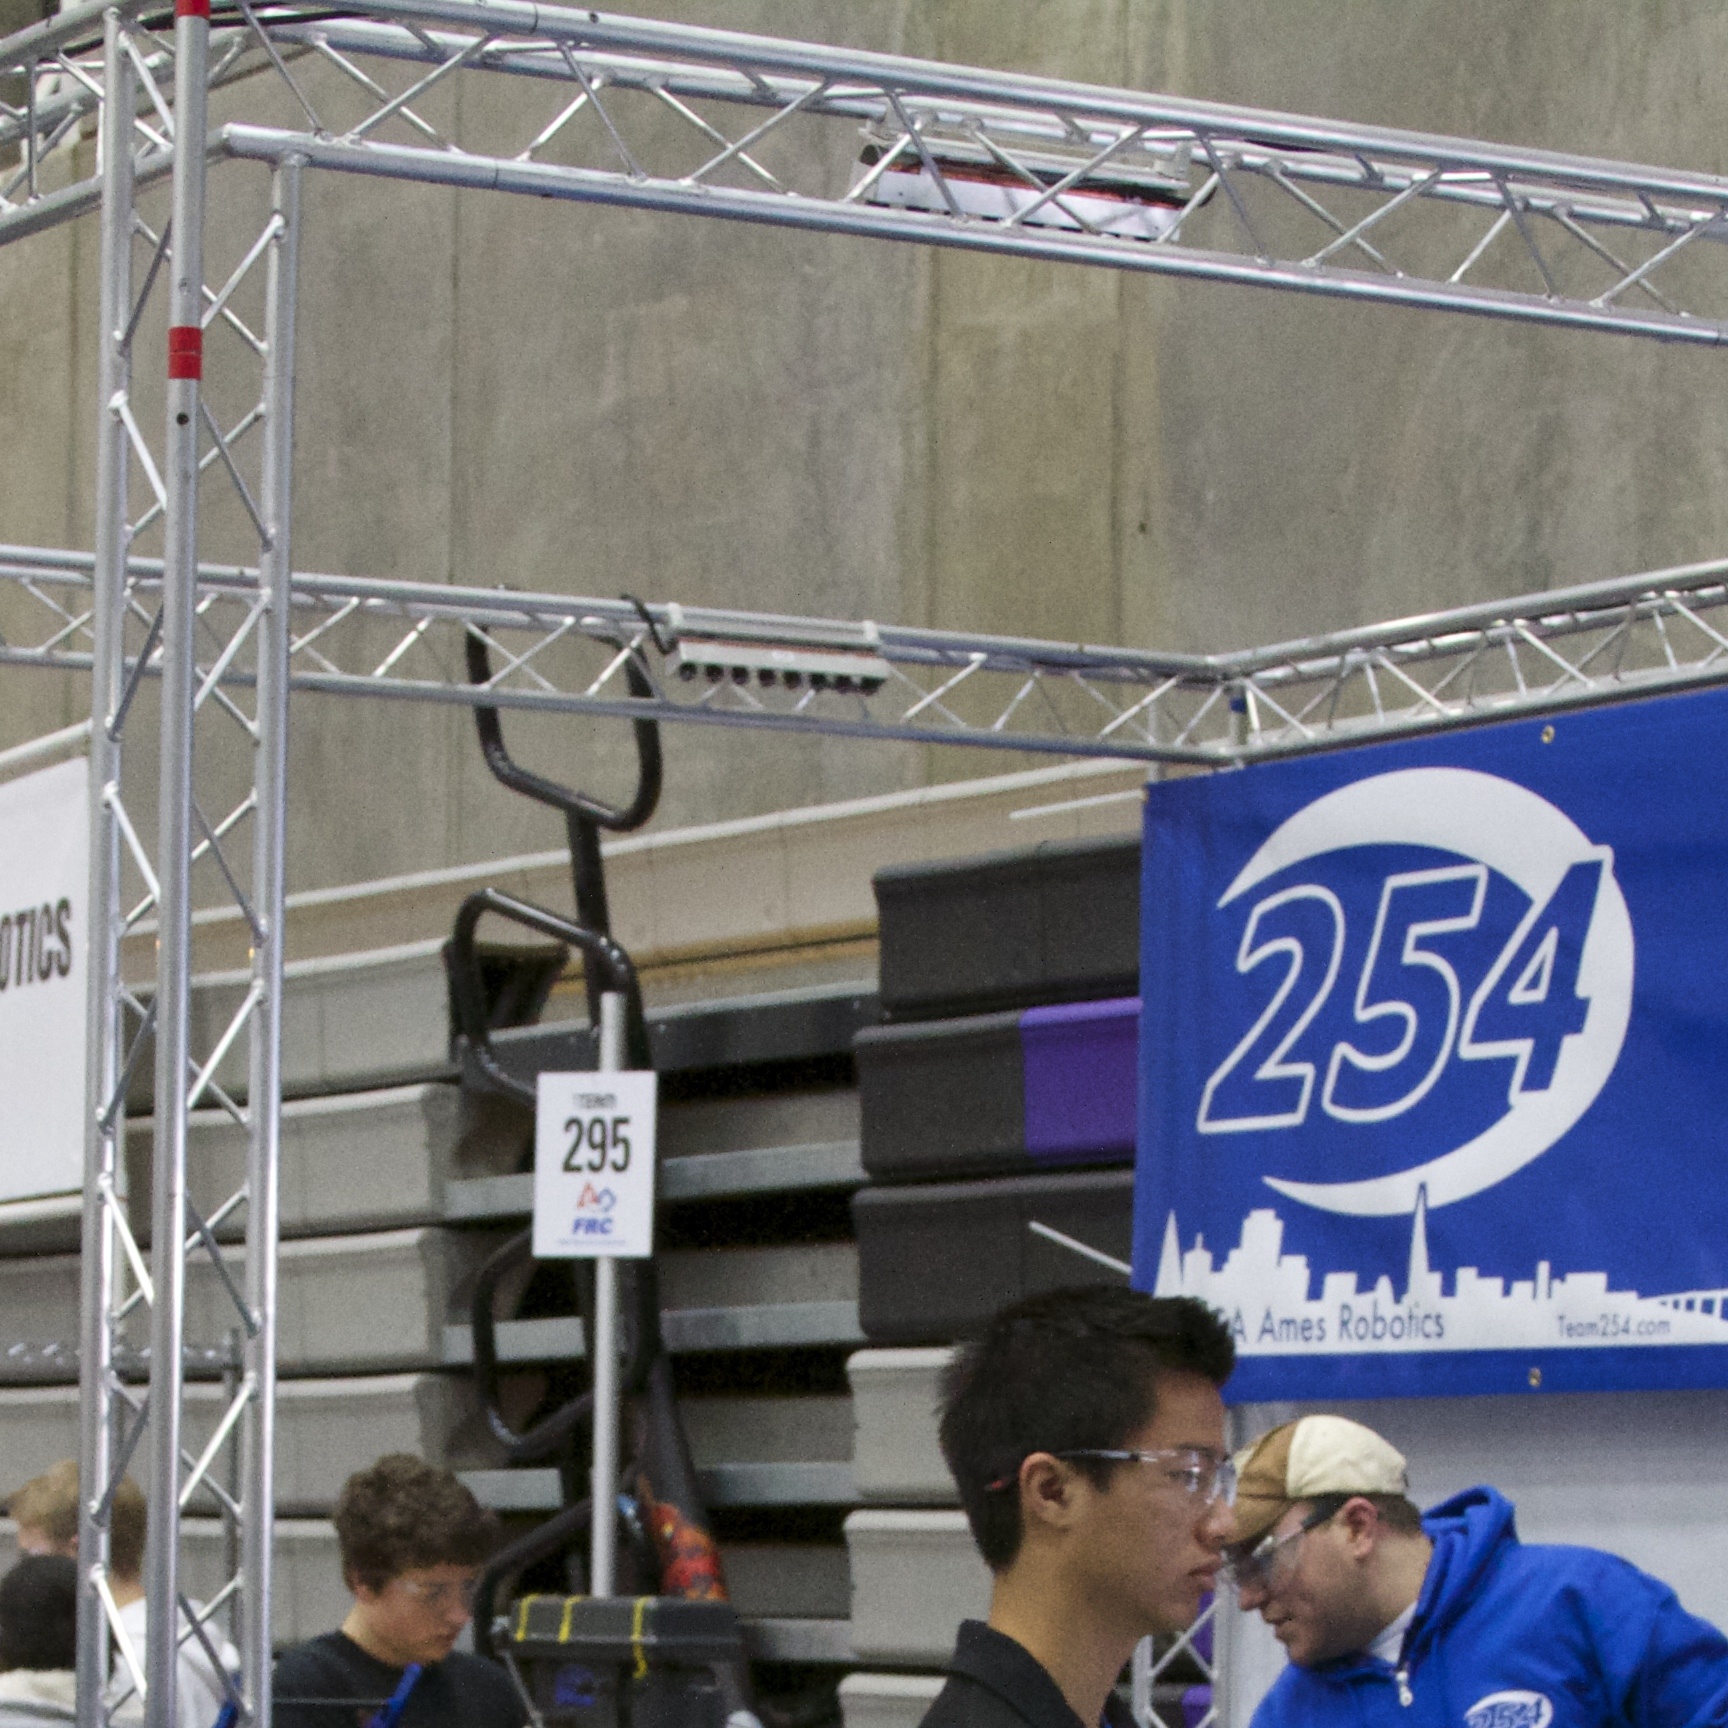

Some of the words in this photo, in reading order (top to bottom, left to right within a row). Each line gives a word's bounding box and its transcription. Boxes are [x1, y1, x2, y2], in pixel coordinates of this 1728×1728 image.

[1197, 846, 1614, 1135] 254
[562, 1116, 632, 1173] 295
[1258, 1307, 1326, 1343] Ames
[1339, 1300, 1444, 1341] Robotics
[1558, 1313, 1671, 1338] Team254.com
